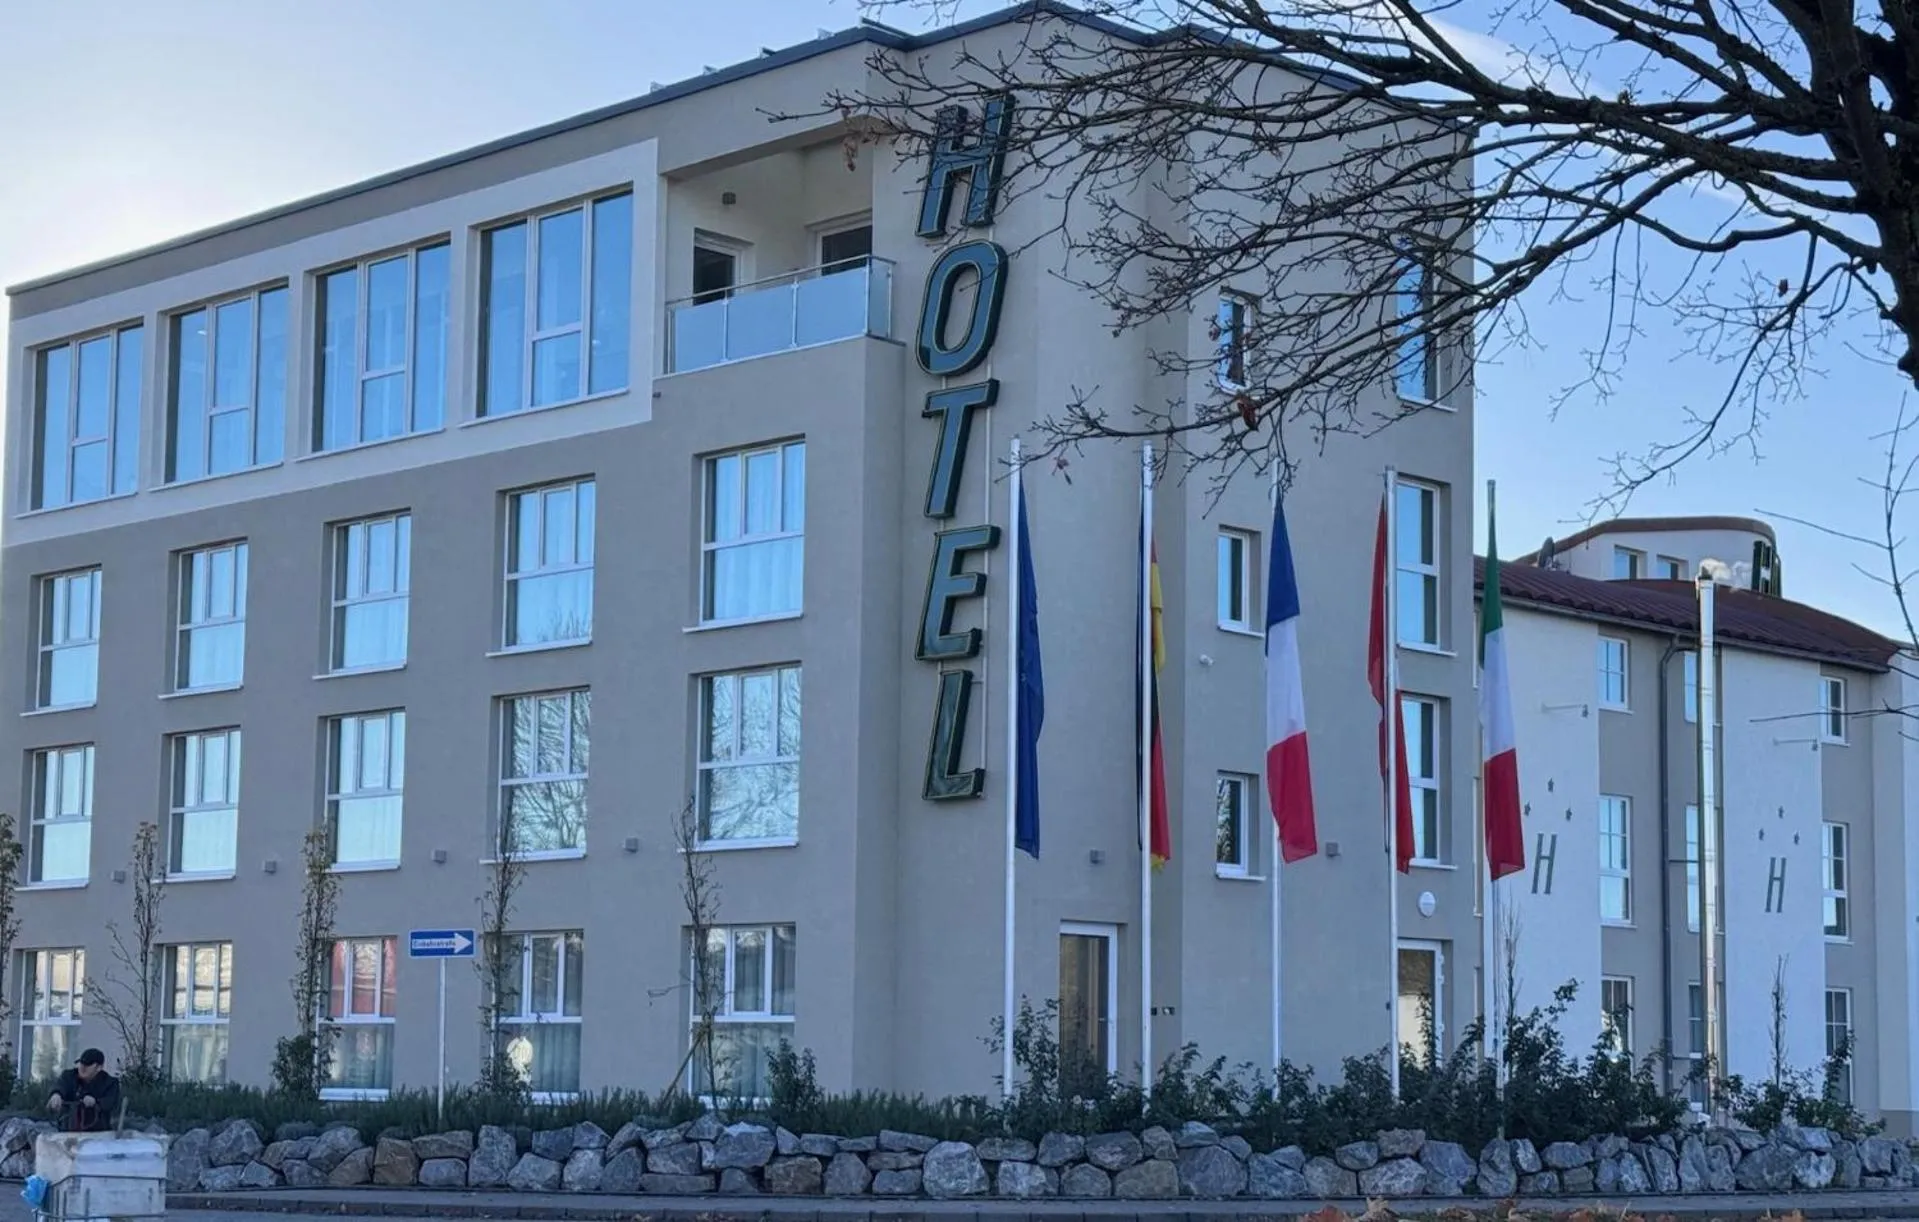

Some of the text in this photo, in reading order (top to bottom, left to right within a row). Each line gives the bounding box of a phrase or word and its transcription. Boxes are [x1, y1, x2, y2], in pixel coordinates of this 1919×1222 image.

[915, 93, 1014, 799] HOTEL
[1531, 833, 1557, 894] H
[1765, 857, 1786, 913] H
